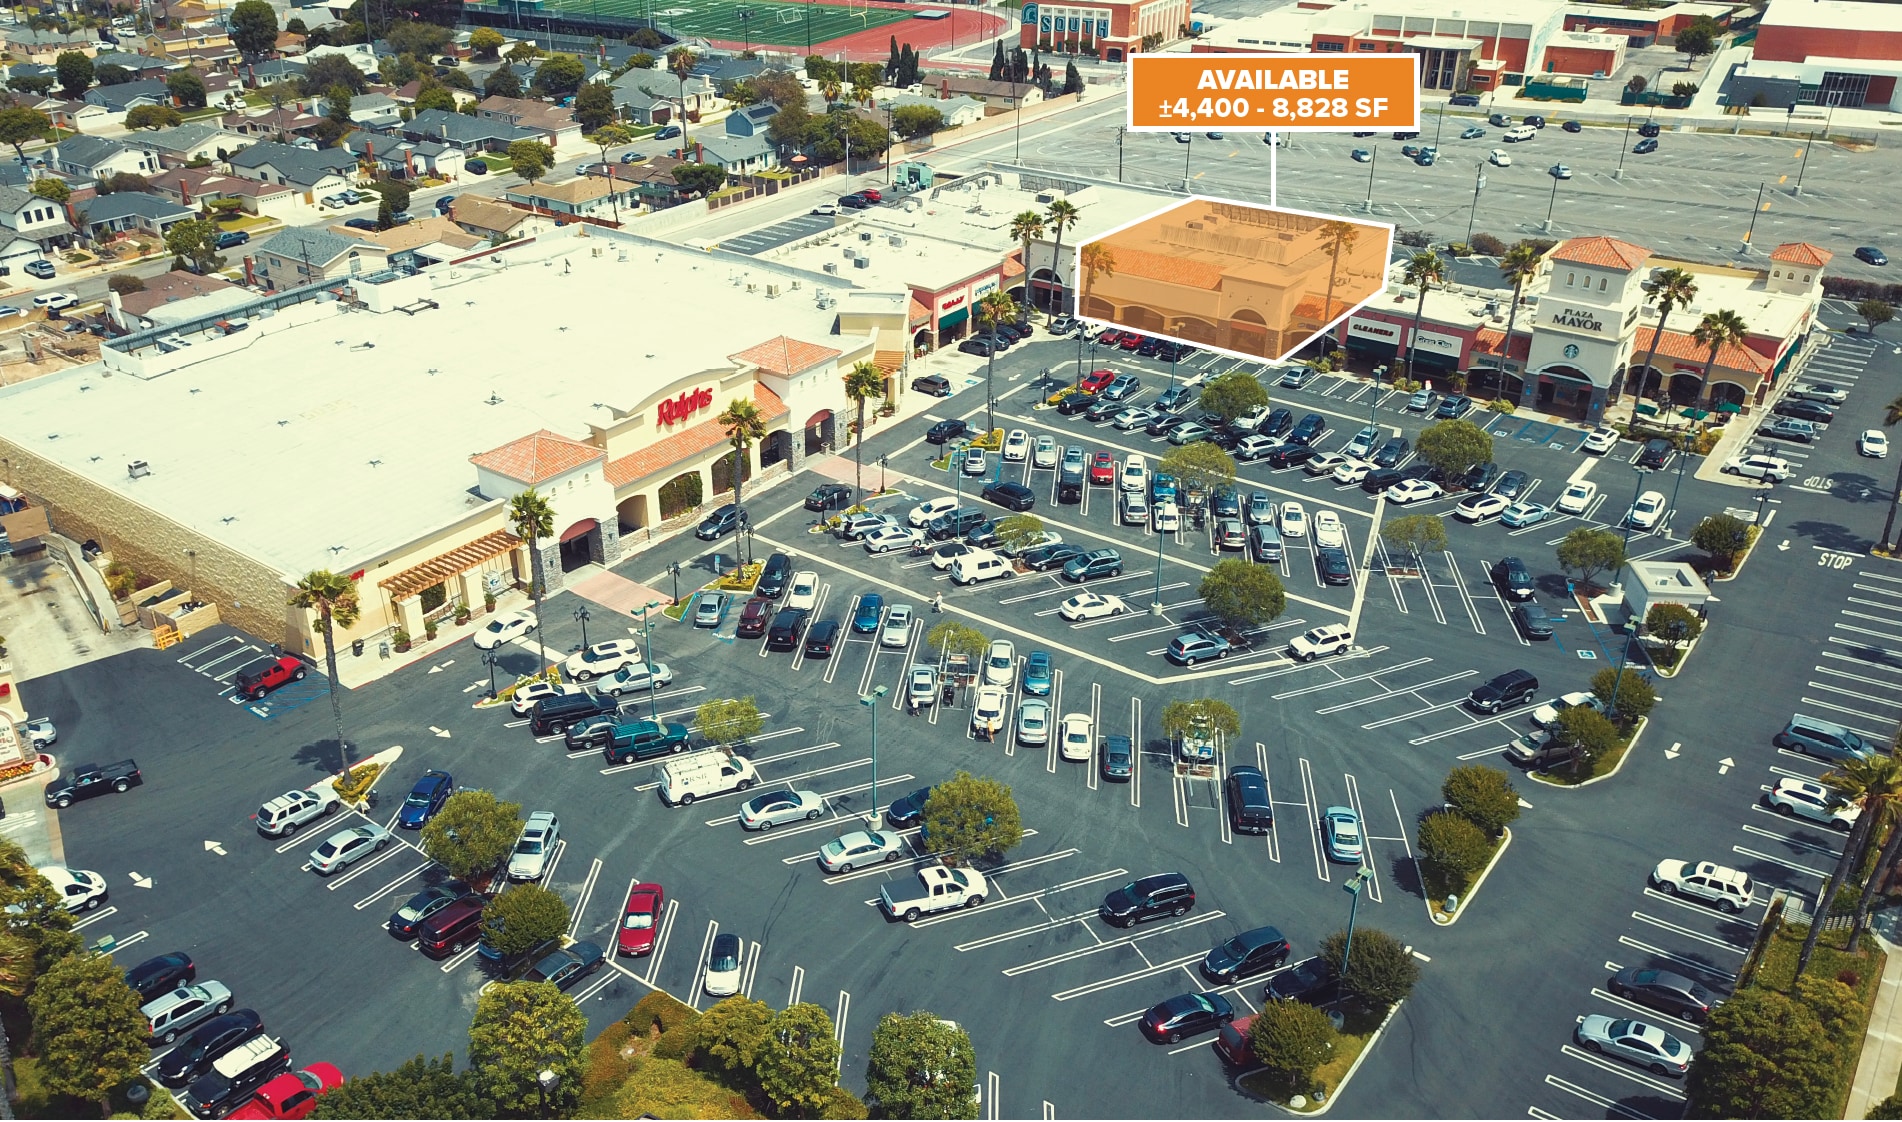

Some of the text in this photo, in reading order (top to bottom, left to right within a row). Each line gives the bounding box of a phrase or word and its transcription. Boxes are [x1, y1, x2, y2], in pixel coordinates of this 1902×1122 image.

[1040, 14, 1109, 39] SOUTH
[1552, 314, 1603, 332] MAYOR
[1563, 308, 1594, 320] PLAZA
[1352, 323, 1394, 338] CLEANERS
[657, 387, 713, 426] Ralphs
[1803, 475, 1834, 490] STOP
[1817, 552, 1854, 570] STOP
